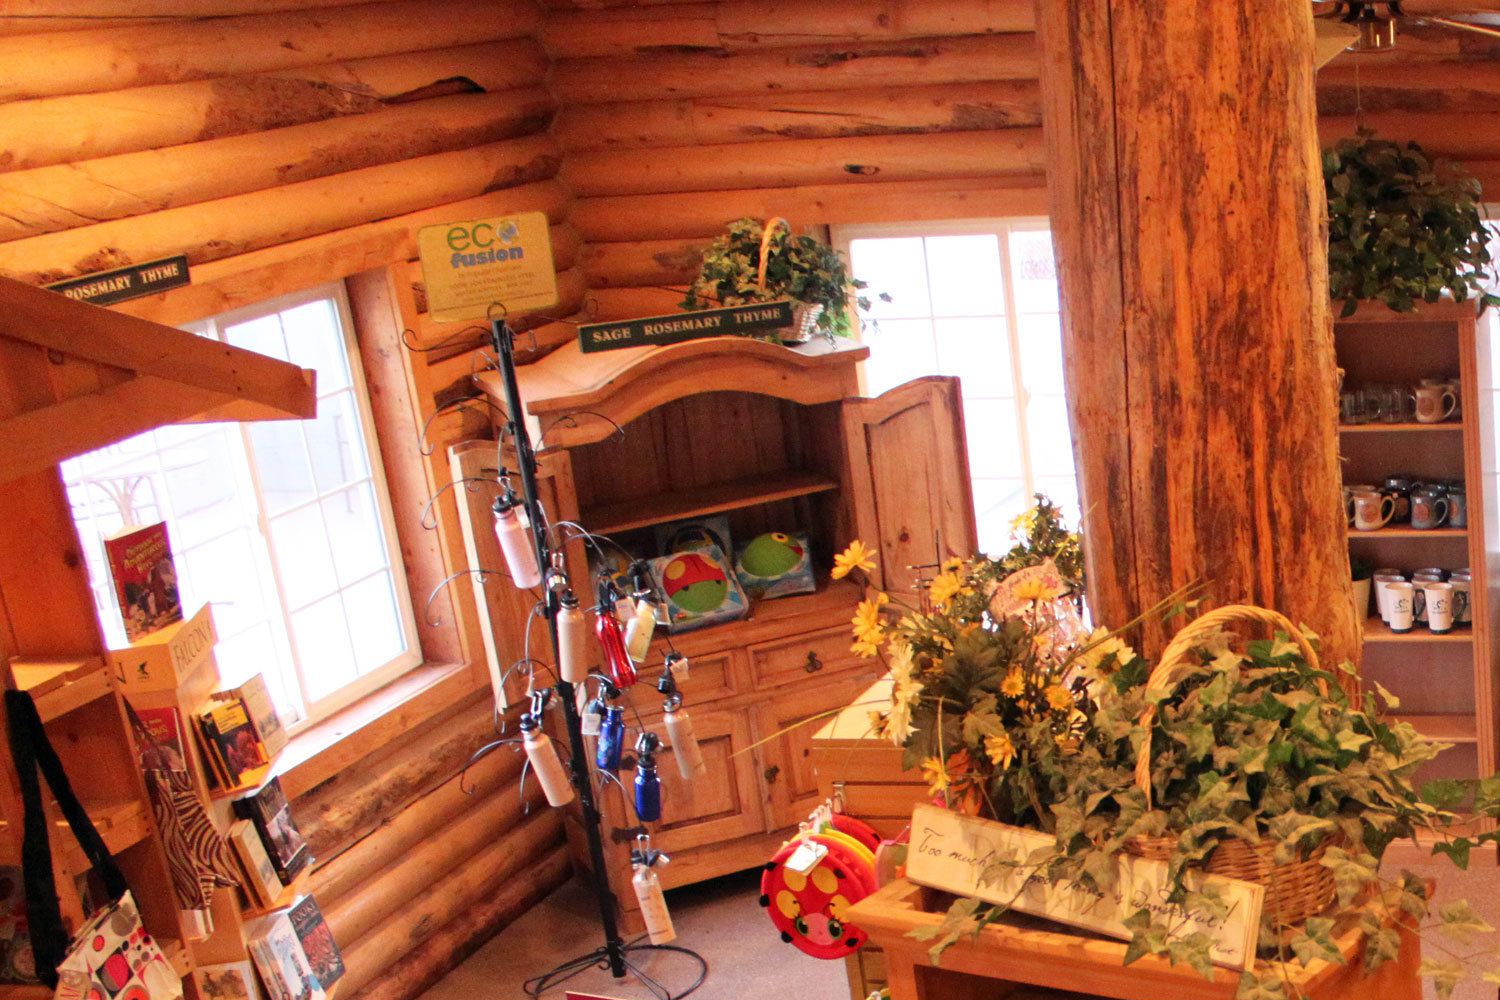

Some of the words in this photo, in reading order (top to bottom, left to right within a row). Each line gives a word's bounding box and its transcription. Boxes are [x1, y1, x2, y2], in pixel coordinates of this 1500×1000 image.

[451, 246, 524, 269] fusion
[139, 263, 180, 285] THYME
[592, 327, 632, 343] SAGE
[643, 316, 722, 336] ROSEMARY
[734, 307, 782, 325] THYME
[918, 827, 944, 857] Too
